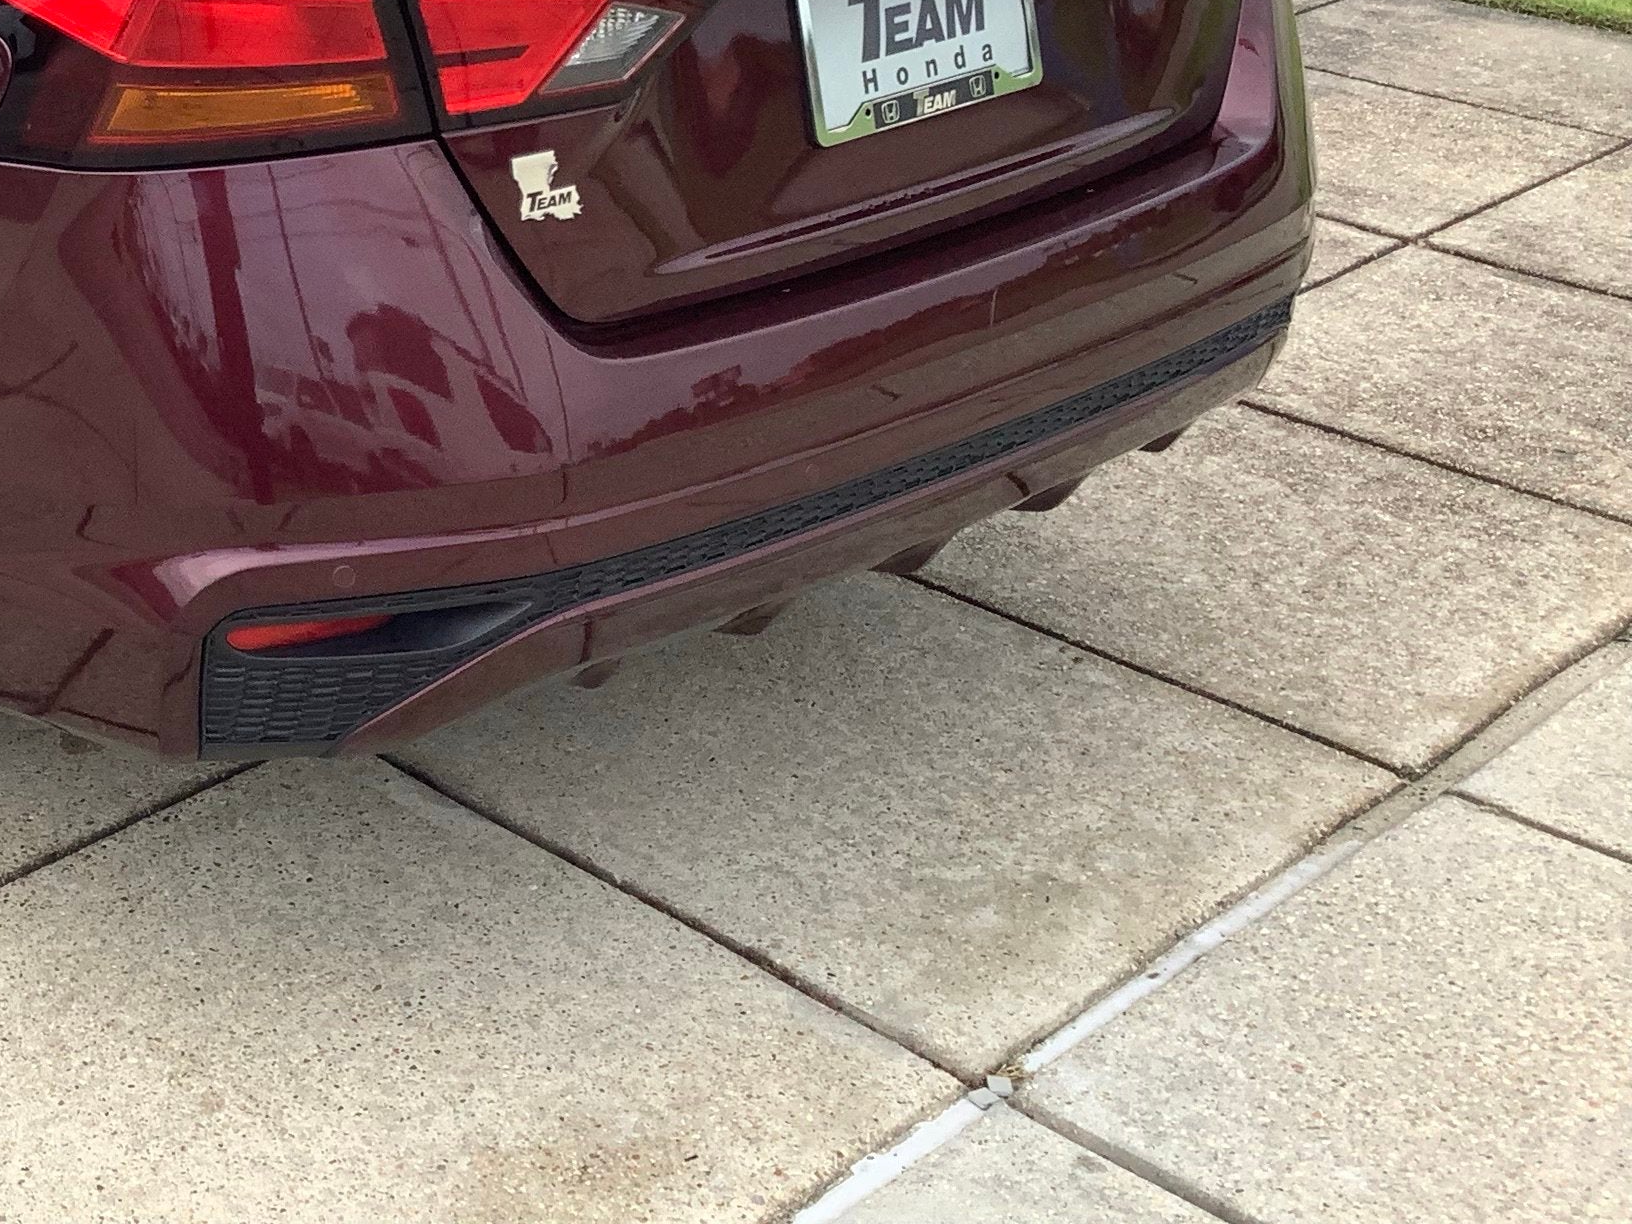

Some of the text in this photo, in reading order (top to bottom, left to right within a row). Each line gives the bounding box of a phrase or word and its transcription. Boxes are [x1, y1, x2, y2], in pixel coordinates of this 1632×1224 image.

[861, 43, 994, 95] Honda
[912, 87, 957, 117] TEAM
[526, 190, 573, 213] TEAM
